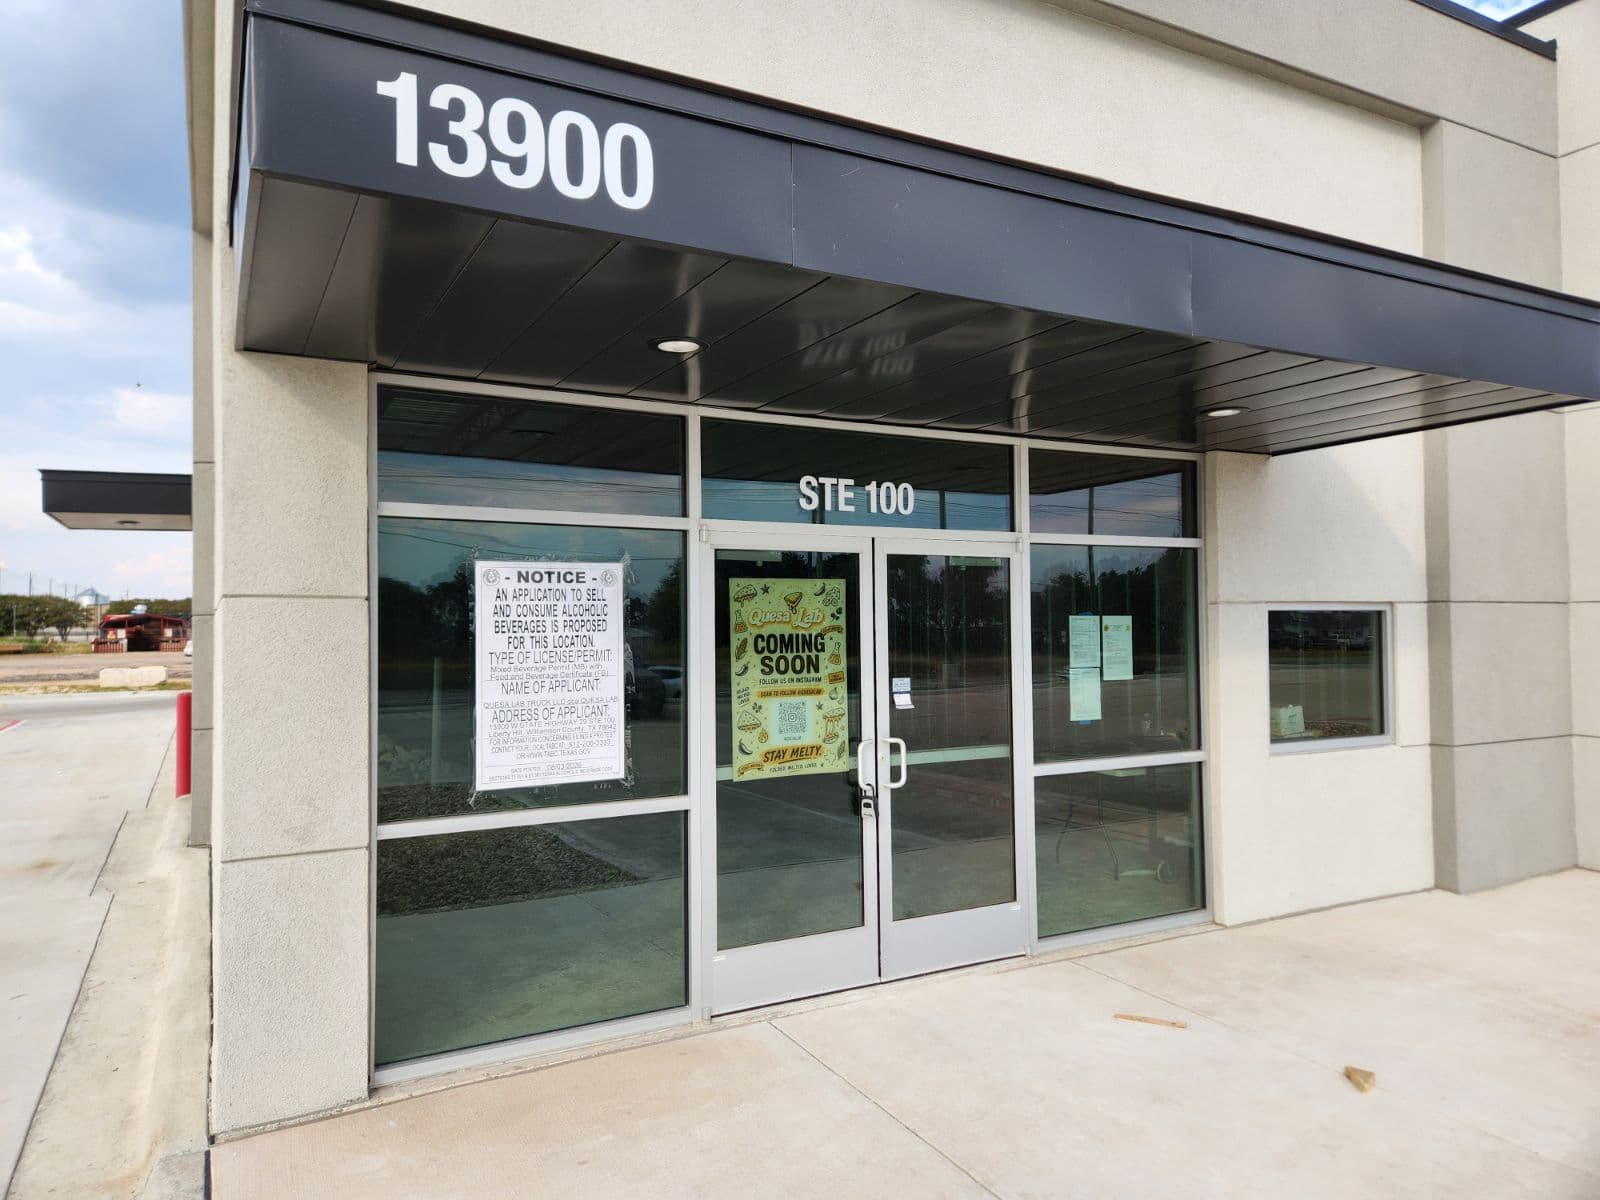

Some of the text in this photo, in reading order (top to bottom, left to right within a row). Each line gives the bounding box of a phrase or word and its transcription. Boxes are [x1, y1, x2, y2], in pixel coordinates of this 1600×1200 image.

[376, 72, 655, 211] 13900
[799, 475, 915, 515] STE 100
[517, 570, 587, 584] NOTICE
[495, 588, 606, 601] AN APPLICATION TO SELL
[493, 603, 609, 618] AND CONSUME ALCOHOLIC
[749, 606, 823, 628] Quesa Lab
[494, 619, 608, 634] BEVERAGES IS PROPOSED
[507, 635, 525, 650] FOR
[530, 635, 549, 649] THIS
[753, 633, 826, 655] COMING
[489, 649, 613, 666] TYPE OF LICENSE/PERMIT:
[760, 654, 820, 676] SOON
[501, 678, 601, 696] NAME OF APPLICANT:
[796, 676, 822, 684] INSTAGRAM
[491, 704, 610, 723] ADDRESS OF APPLICANT:
[763, 744, 823, 763] STAY MELTY.
